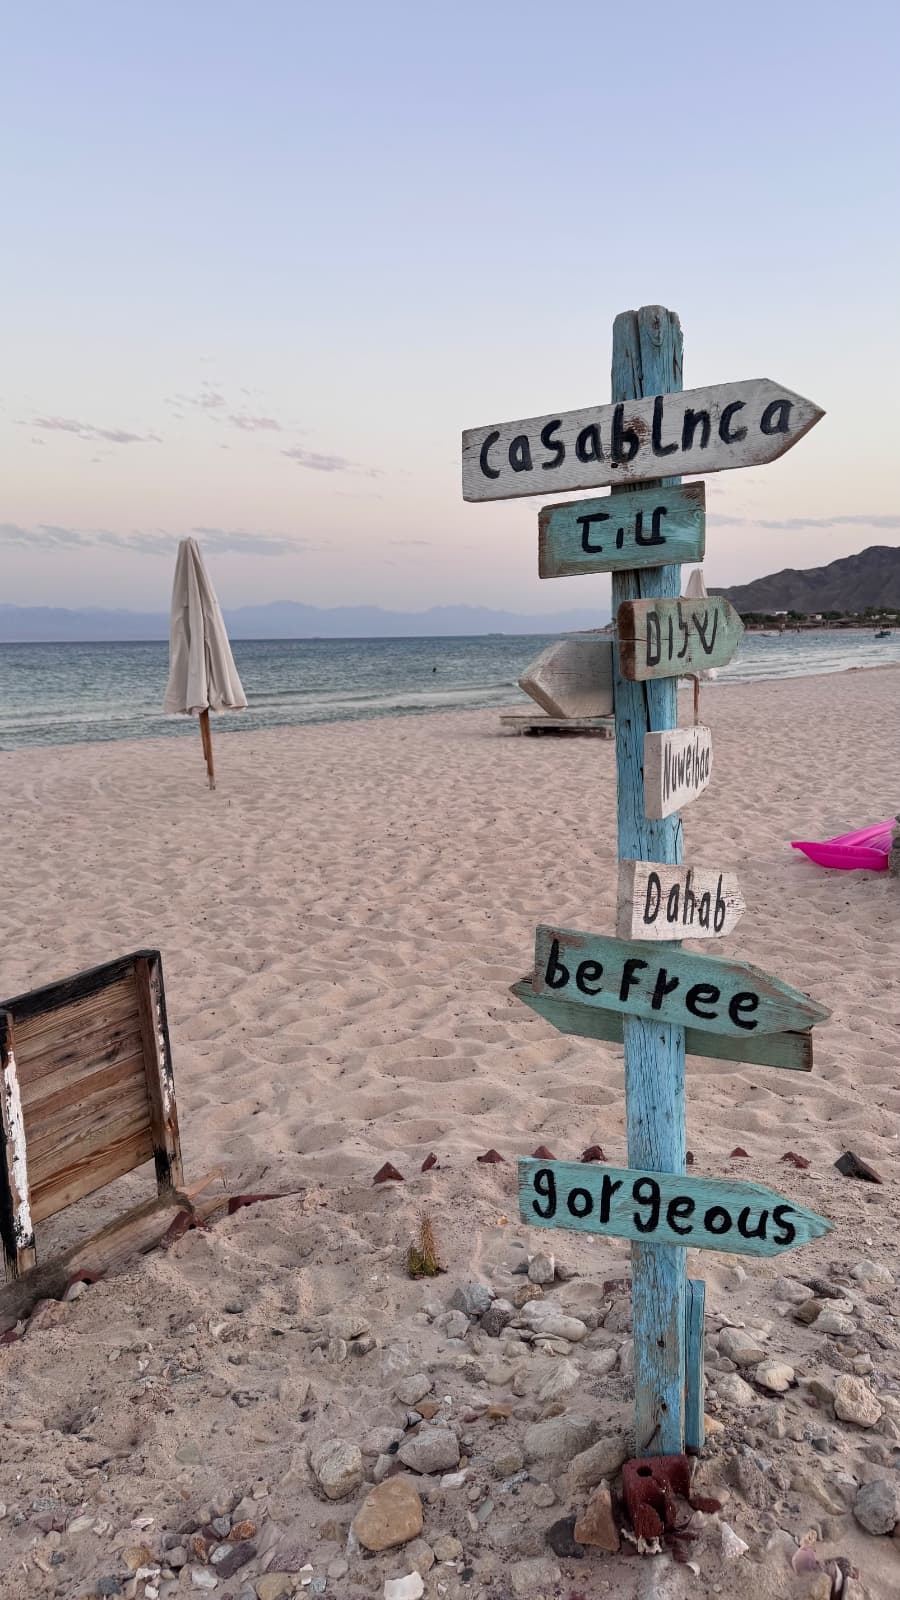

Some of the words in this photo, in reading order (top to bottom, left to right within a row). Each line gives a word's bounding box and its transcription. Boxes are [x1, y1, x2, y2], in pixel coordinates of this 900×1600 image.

[646, 602, 719, 667] שלום
[643, 869, 727, 933] Dahab
[544, 938, 604, 996] be
[532, 1168, 797, 1246] gorgeous
